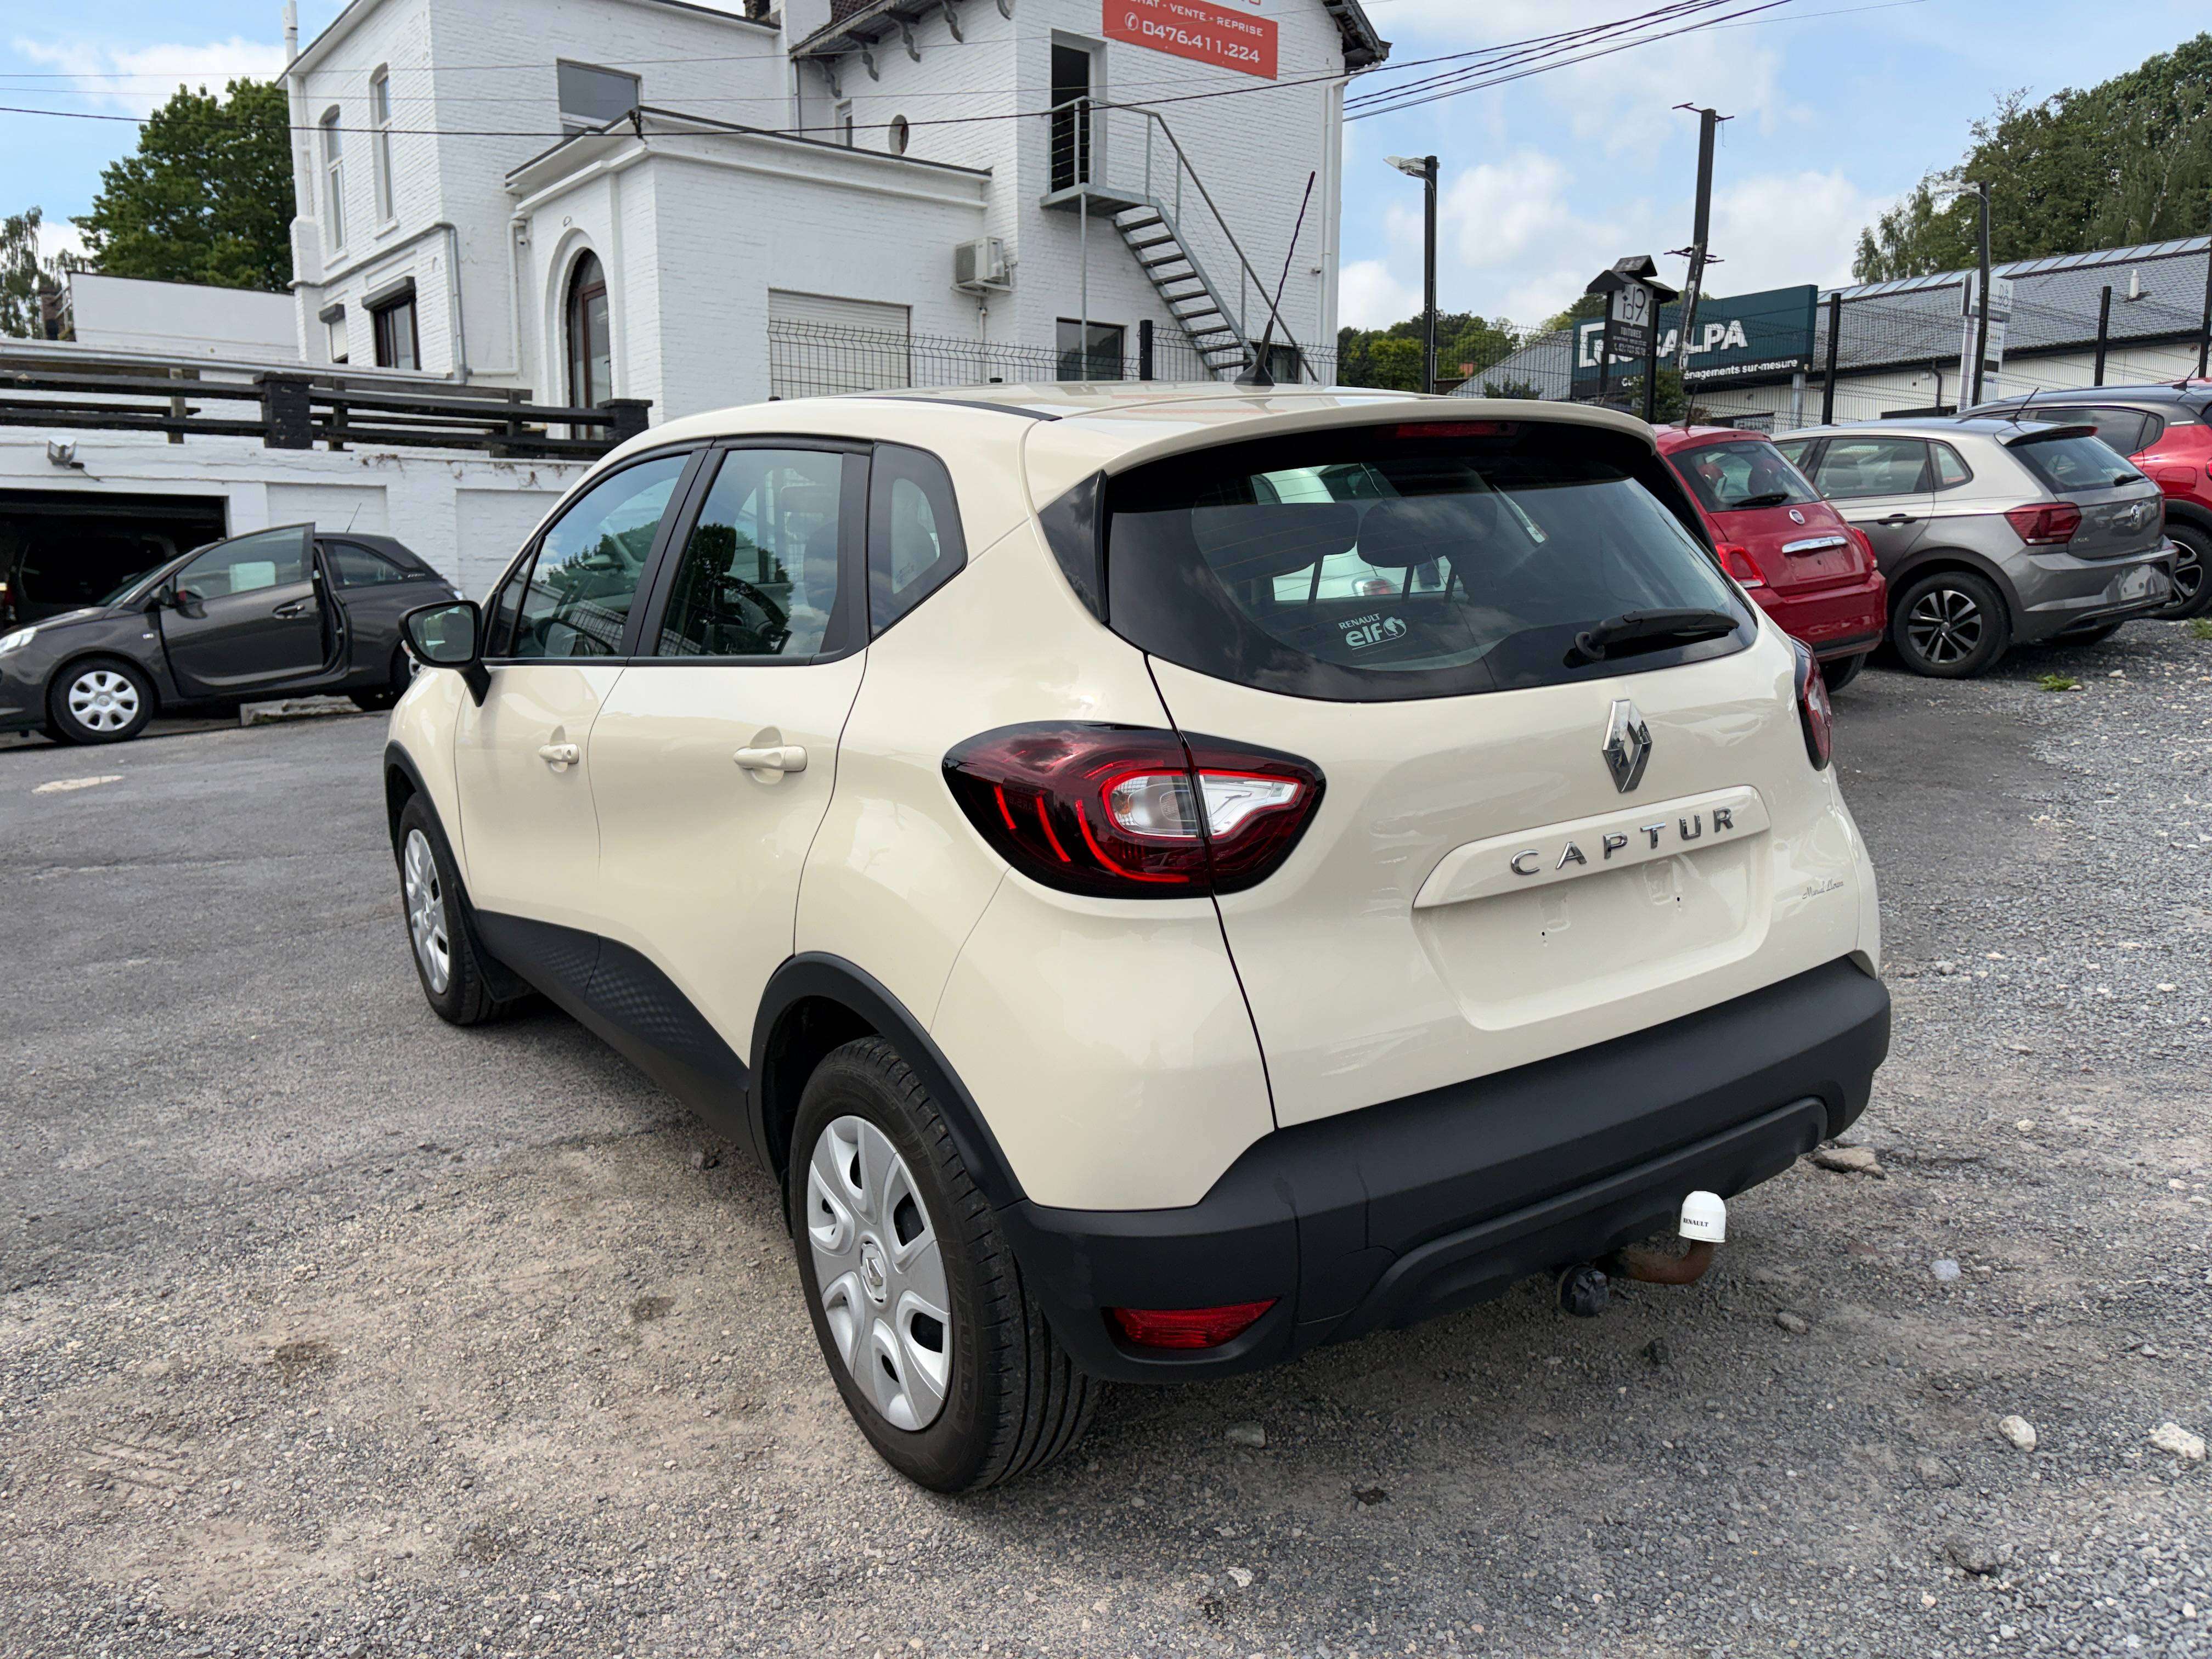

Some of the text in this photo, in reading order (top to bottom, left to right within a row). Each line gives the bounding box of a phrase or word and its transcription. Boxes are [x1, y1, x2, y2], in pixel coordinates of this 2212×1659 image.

[1170, 3, 1206, 21] VENTE
[1217, 16, 1263, 36] REPRISE
[1142, 20, 1260, 63] 0476.411.224
[1742, 359, 1798, 374] sur-mesure
[1338, 613, 1381, 630] RENAULT
[1345, 622, 1383, 647] elf
[1510, 806, 1734, 876] CAPTUR
[1683, 1217, 1709, 1227] RENAULT
